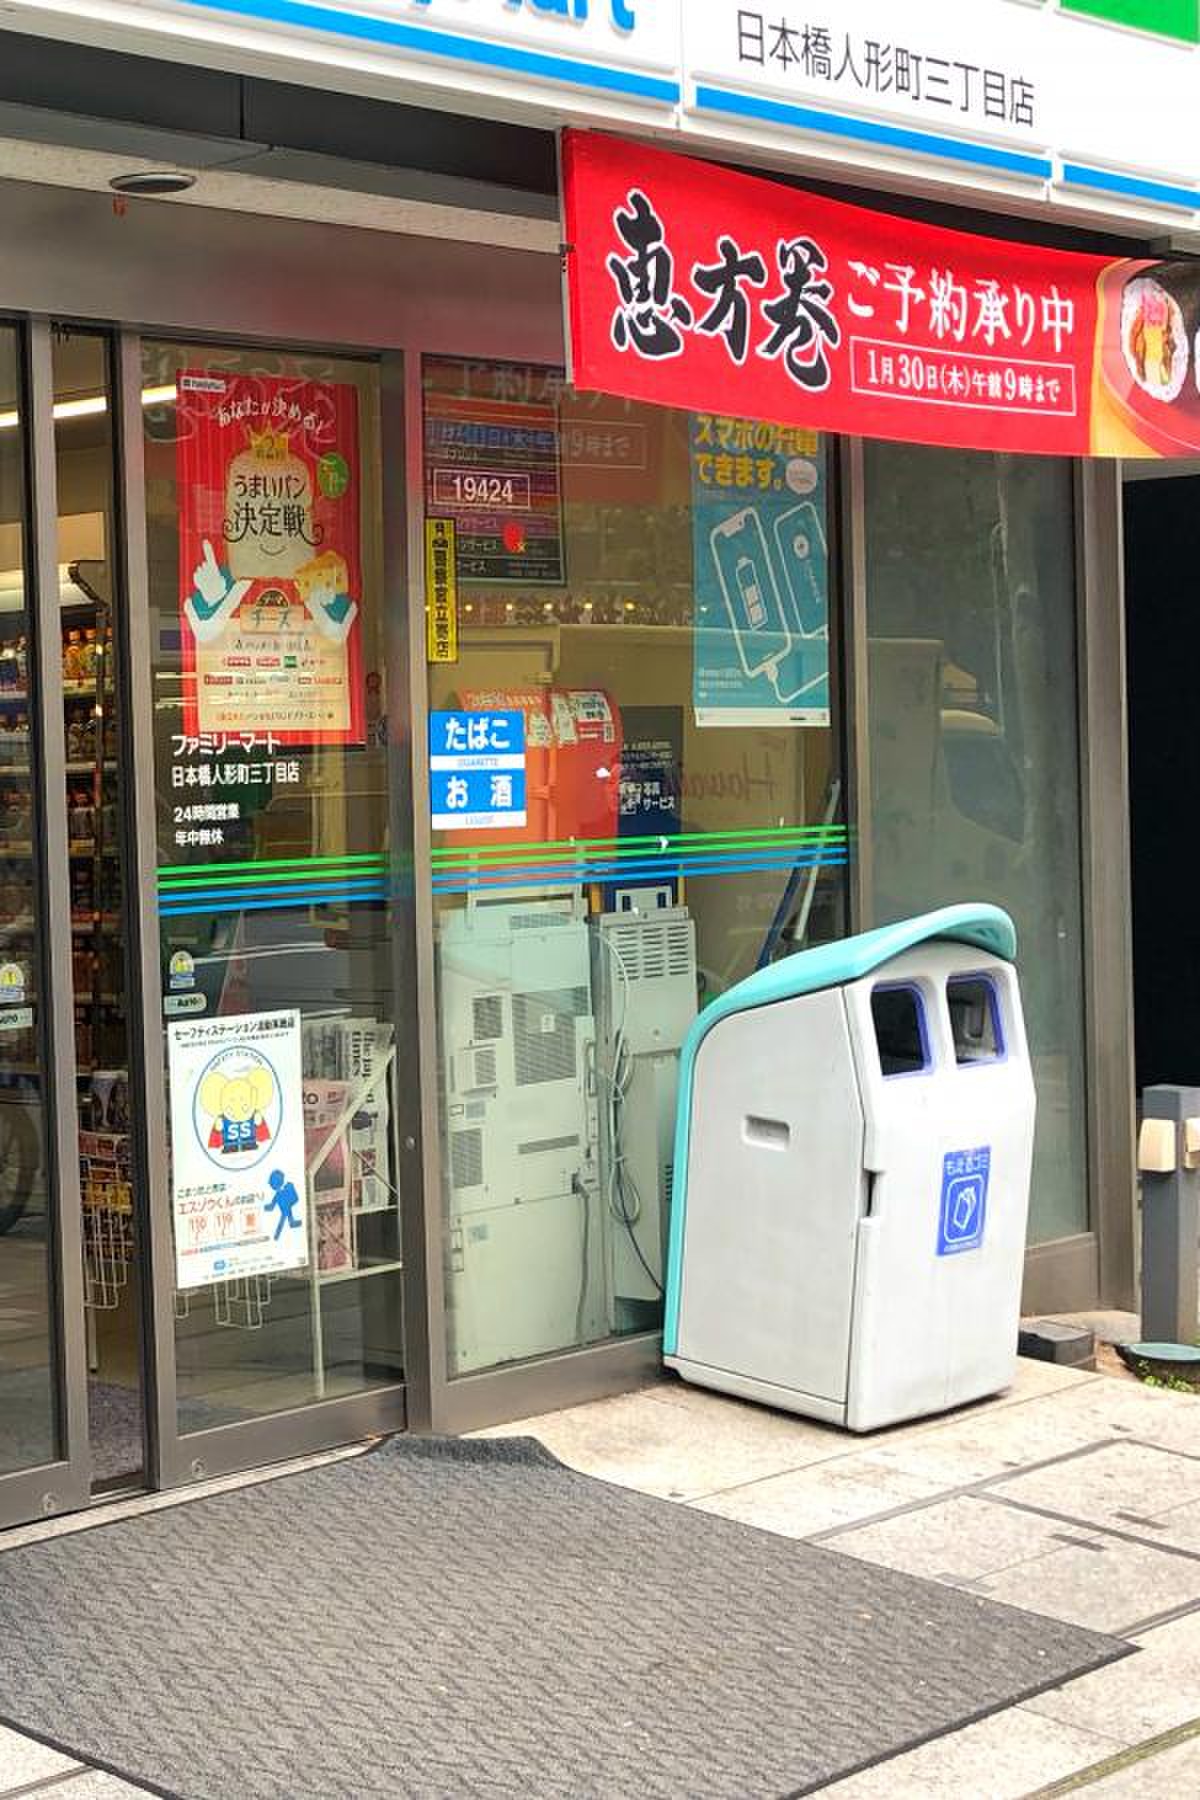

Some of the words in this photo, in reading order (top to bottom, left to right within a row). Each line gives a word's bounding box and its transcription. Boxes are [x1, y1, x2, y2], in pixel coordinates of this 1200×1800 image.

[737, 9, 1035, 127] 日本橋人形町三丁目店
[605, 187, 840, 392] 恵方巻
[846, 259, 1075, 353] ご予約承り中
[866, 348, 1062, 404] 1月30日(木)午前9時まで
[232, 473, 307, 499] うまいパン
[452, 477, 513, 502] 19424
[232, 500, 307, 540] 決定戦
[171, 731, 281, 756] ファミリーマート
[445, 716, 511, 750] たばこ
[171, 760, 300, 787] 日本橋人形町三丁目店
[446, 775, 513, 809] お酒
[173, 802, 240, 822] 24時間営業
[175, 828, 225, 847] 年中無休
[227, 1122, 252, 1141] SS
